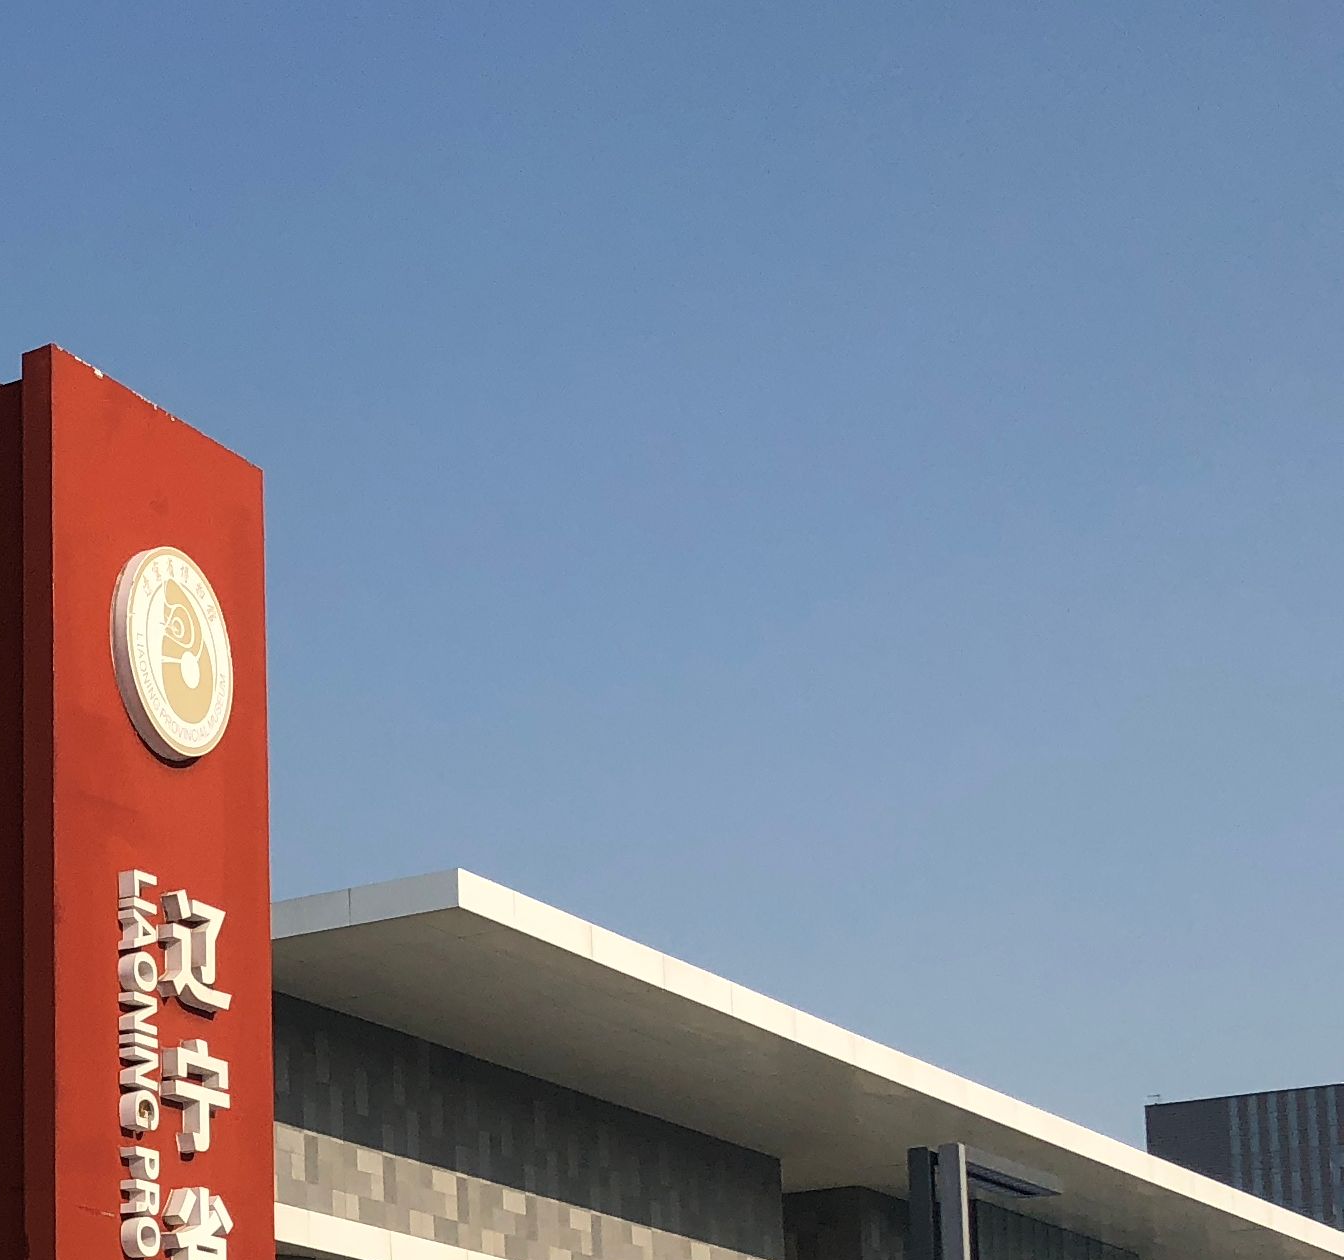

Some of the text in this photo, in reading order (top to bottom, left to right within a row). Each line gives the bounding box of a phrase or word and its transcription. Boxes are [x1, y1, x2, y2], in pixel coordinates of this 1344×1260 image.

[136, 631, 227, 744] LIAONING PROVINCIAL MUSEUM
[119, 869, 160, 1132] LIAONING
